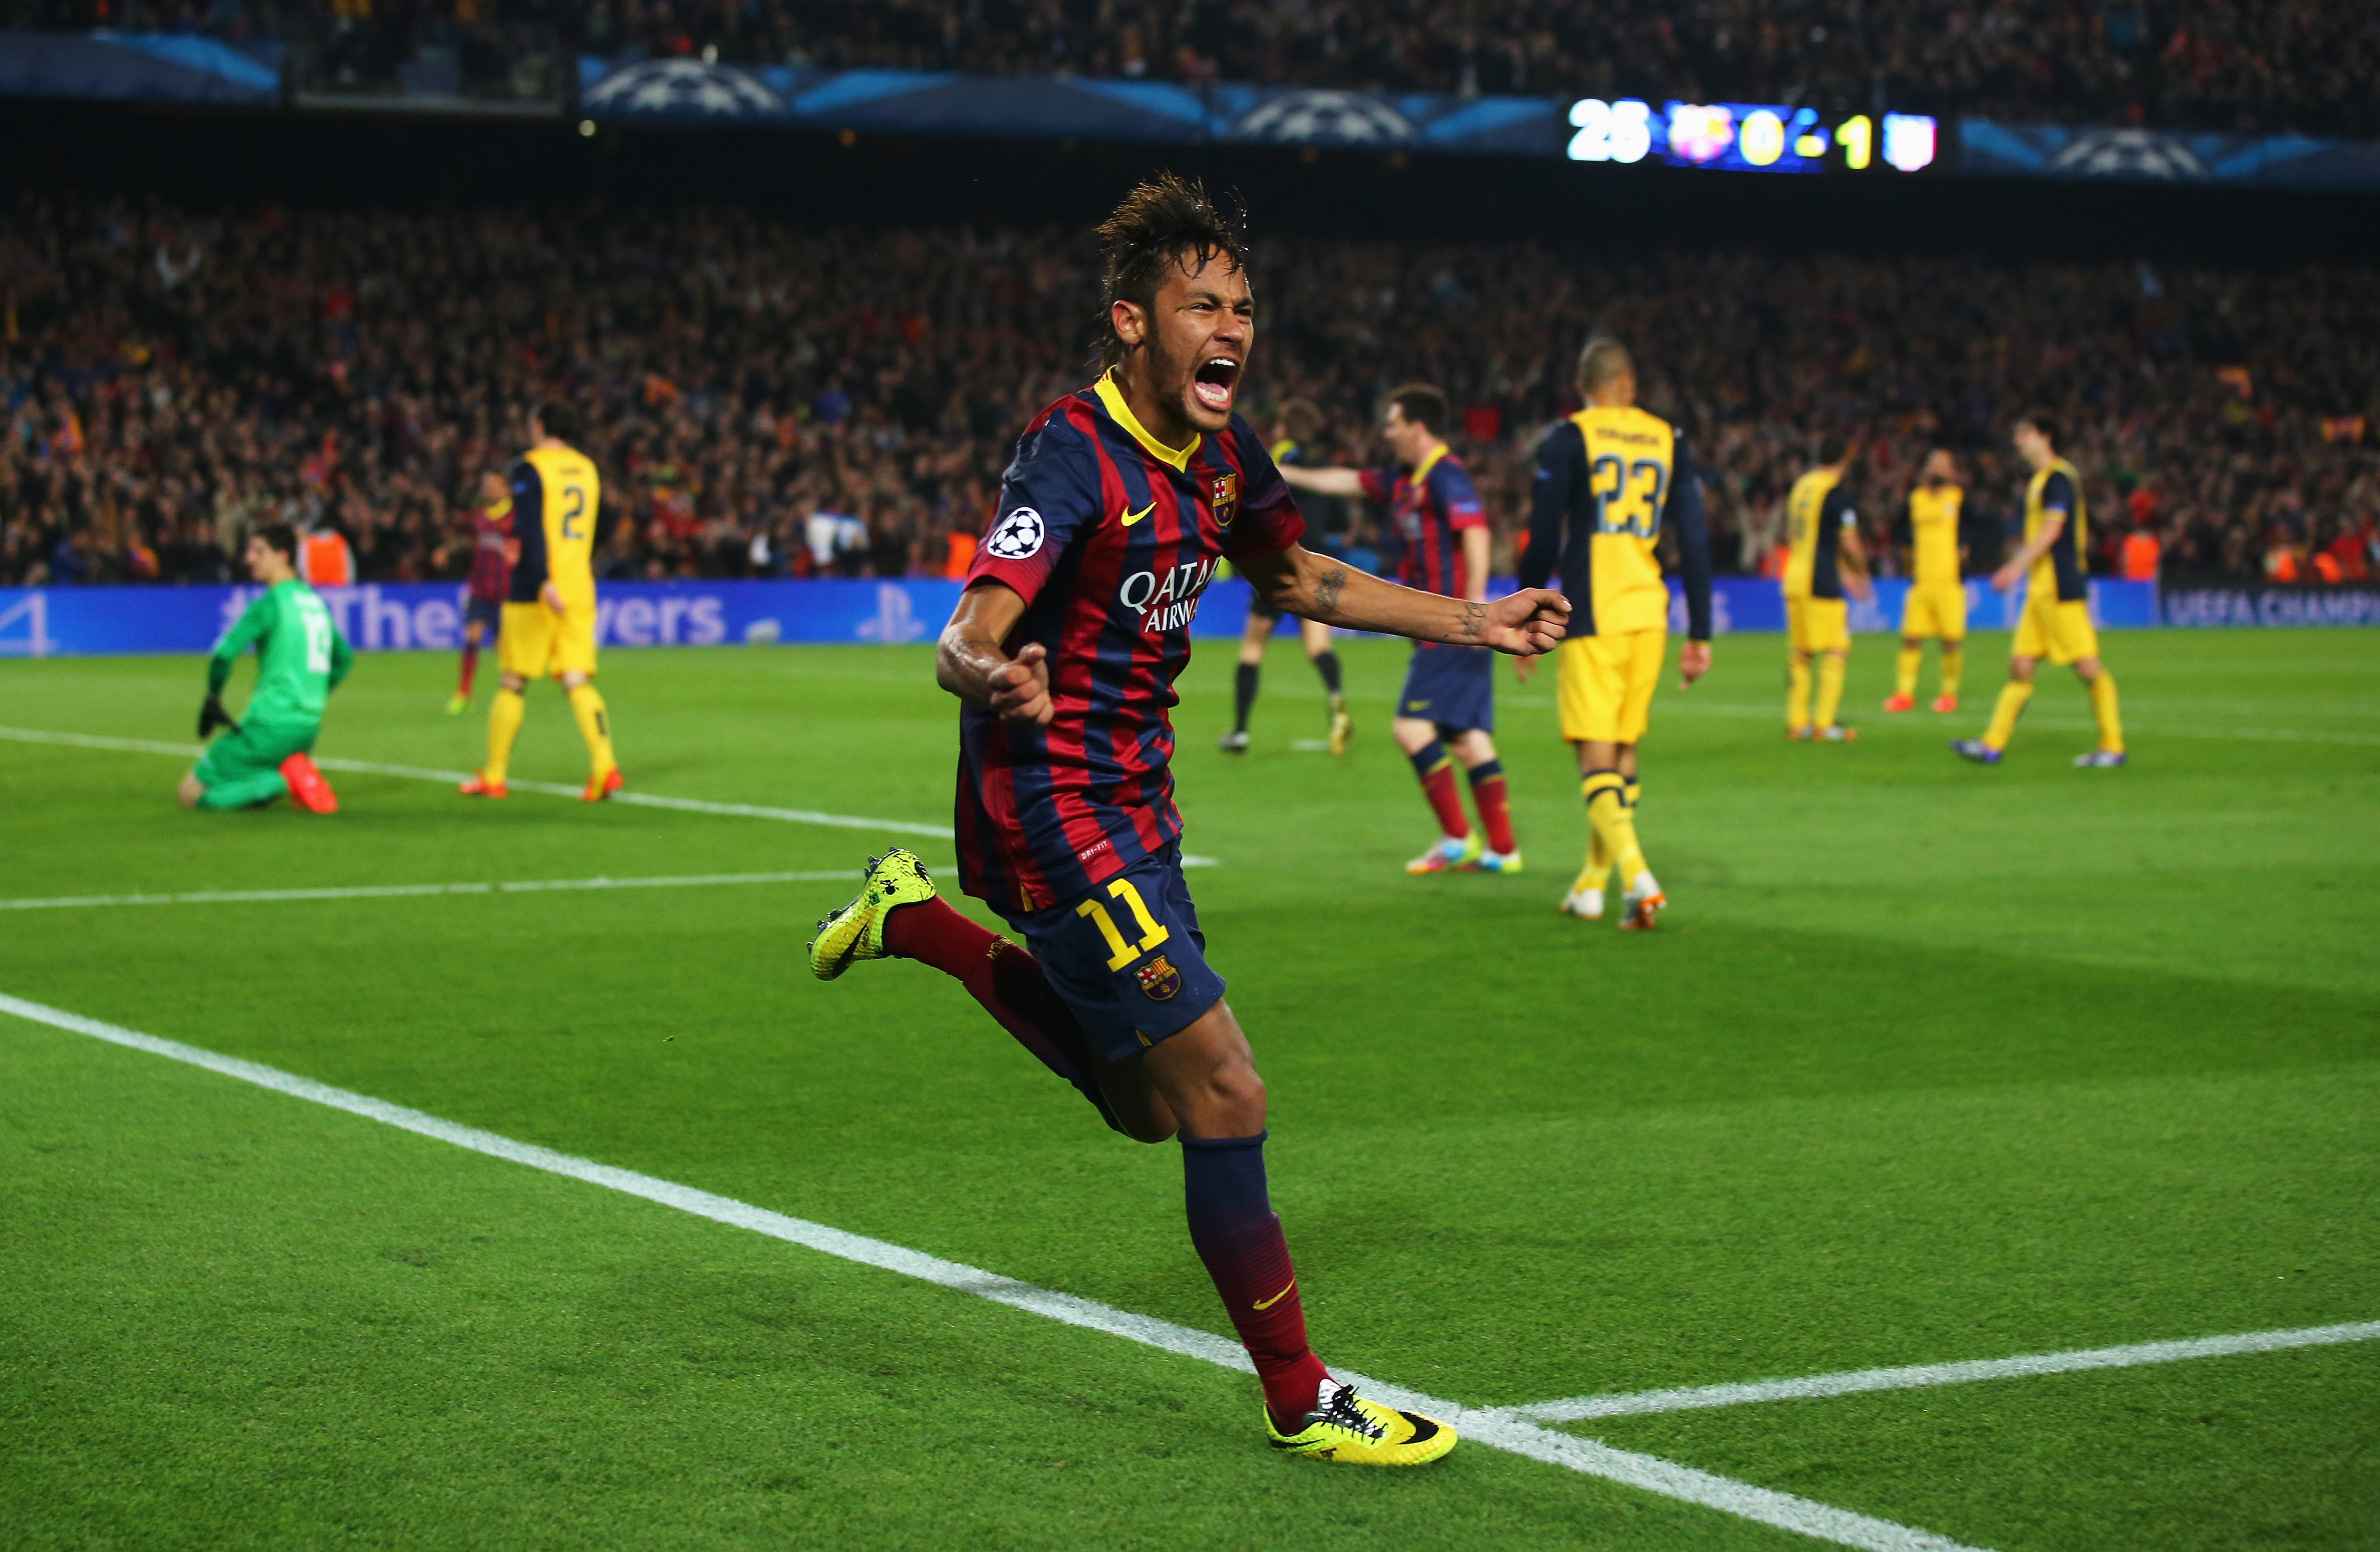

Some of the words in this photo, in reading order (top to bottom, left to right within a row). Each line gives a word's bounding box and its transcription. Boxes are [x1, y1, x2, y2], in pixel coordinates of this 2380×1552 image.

[1740, 109, 1784, 166] 0
[1836, 115, 1872, 169] 1
[561, 485, 584, 540] 2
[1594, 454, 1666, 539] 23
[1081, 840, 1108, 860] DRI-FIT
[1075, 878, 1169, 973] 11
